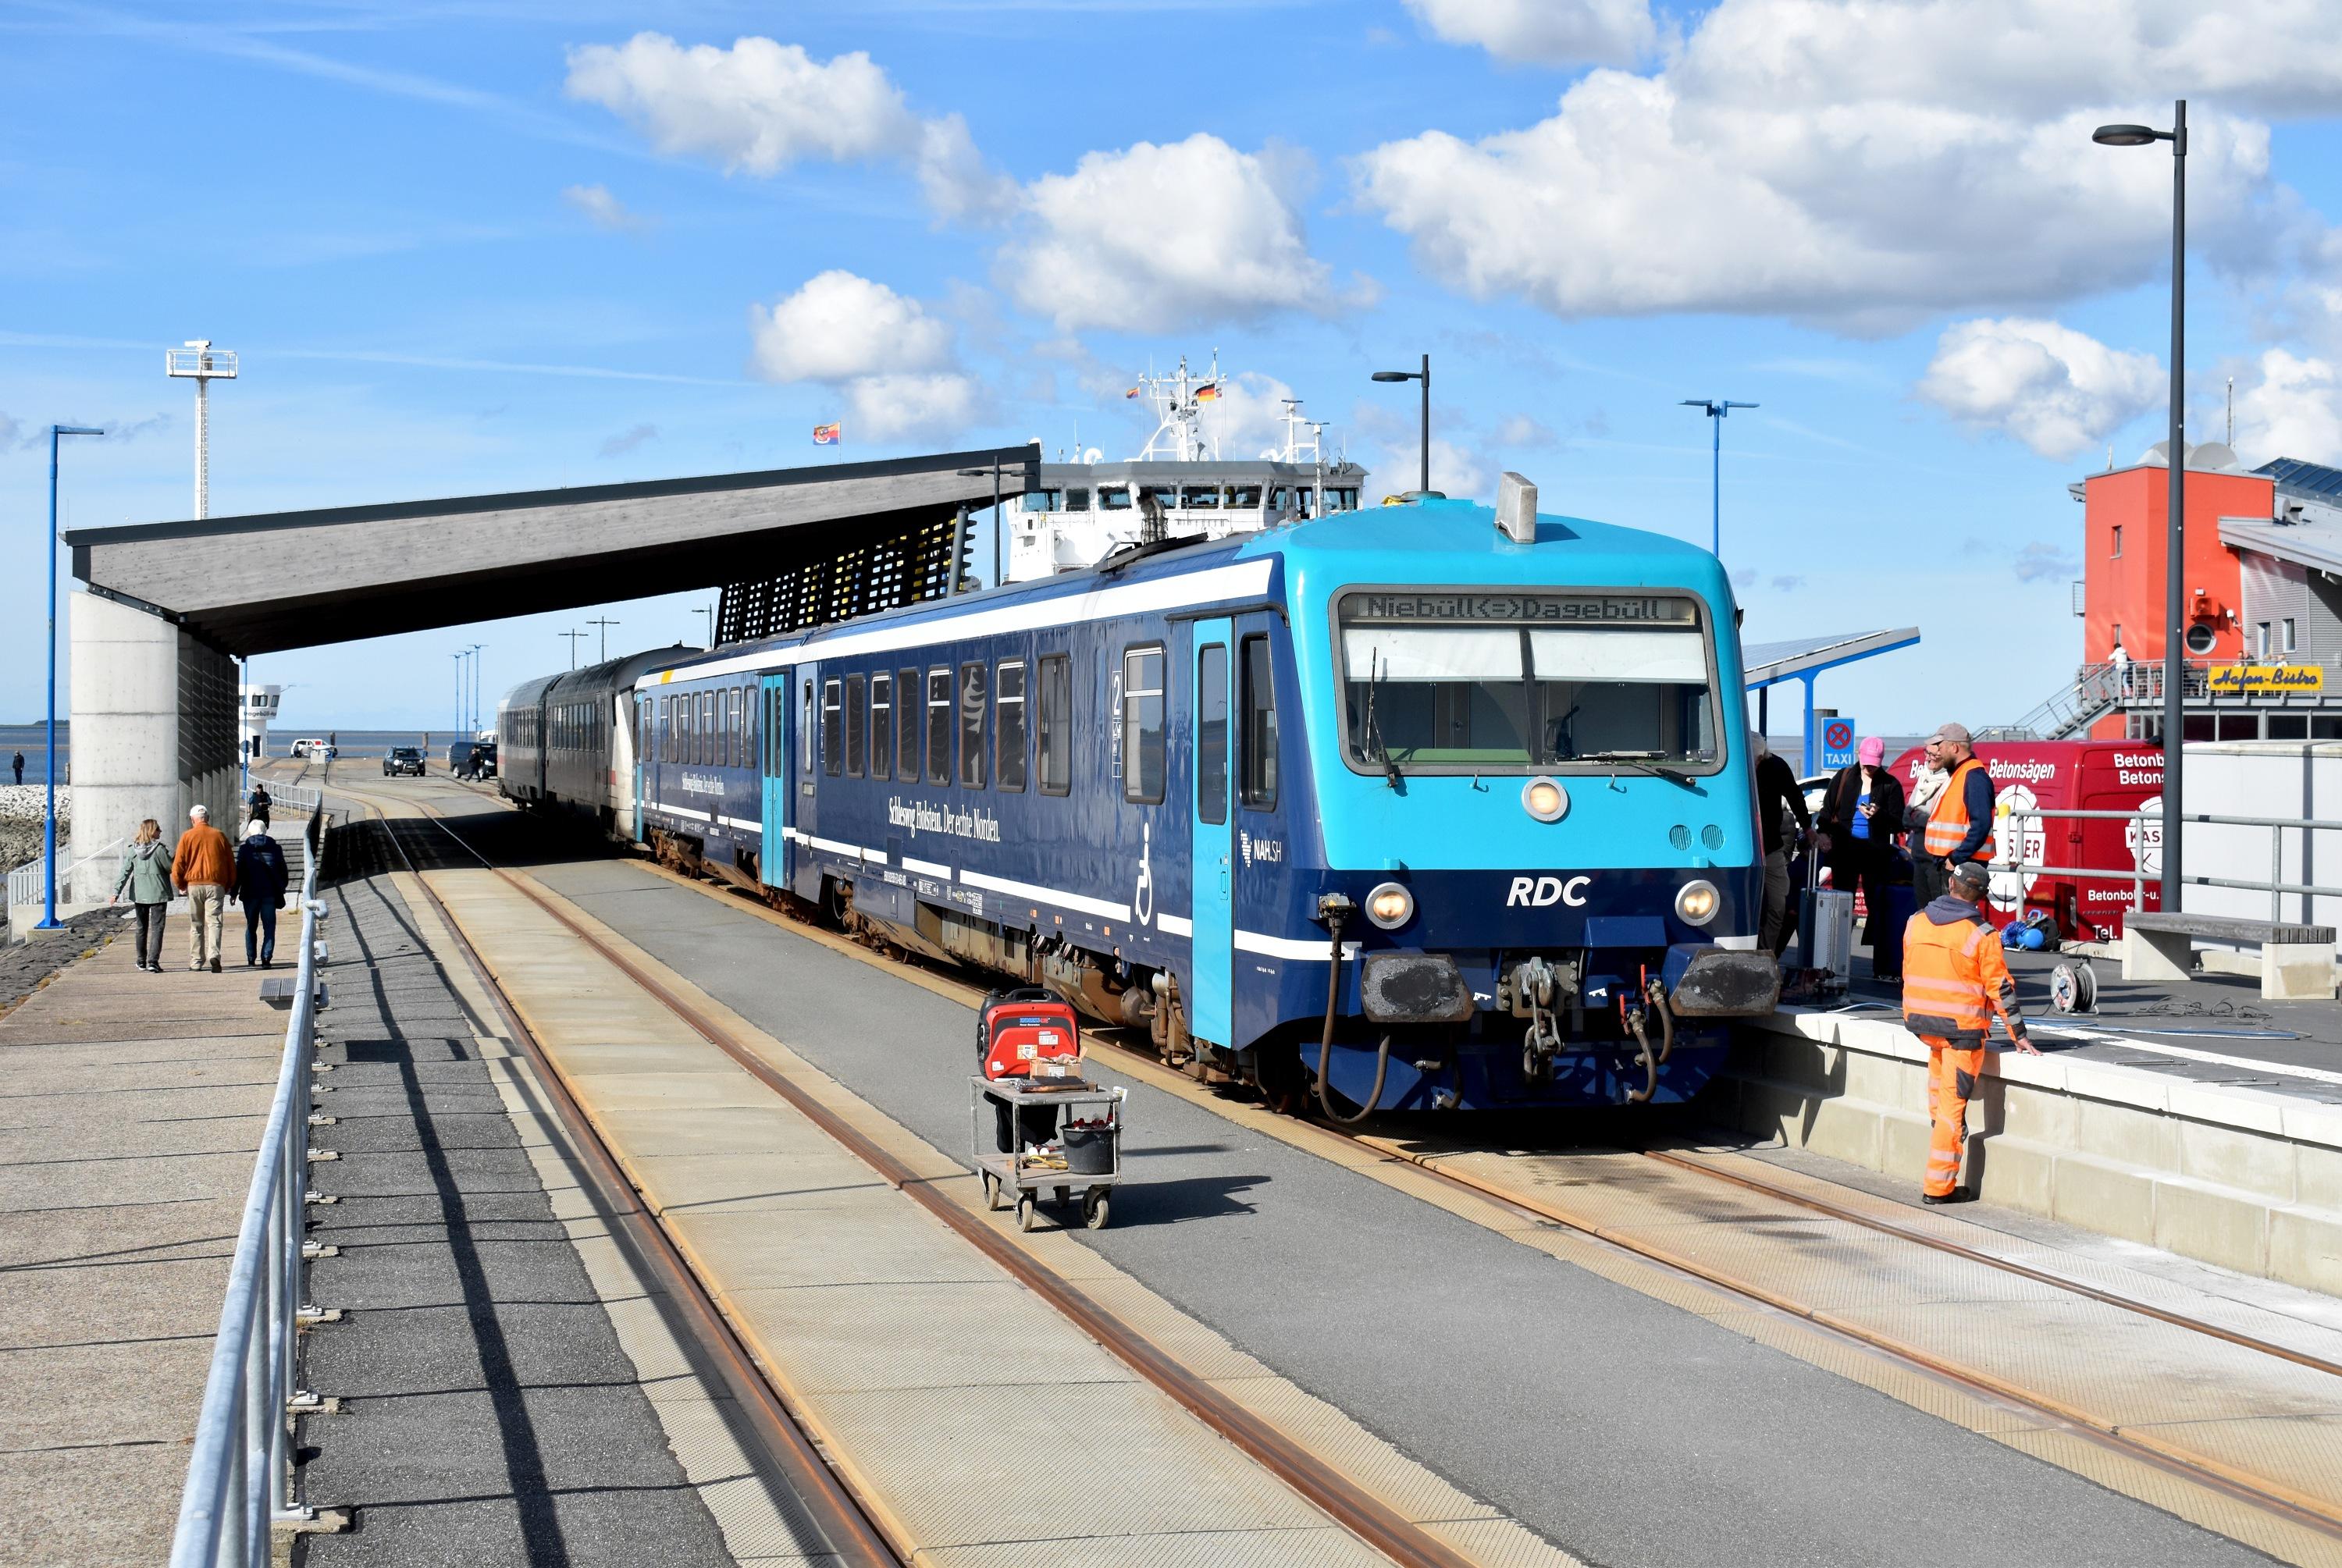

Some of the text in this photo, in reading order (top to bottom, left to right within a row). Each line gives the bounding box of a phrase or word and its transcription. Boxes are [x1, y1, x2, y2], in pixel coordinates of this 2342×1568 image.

[2212, 668, 2318, 691] Hafen-Bistro
[1113, 674, 1121, 716] 2
[1825, 753, 1852, 765] TAXI
[1909, 759, 1927, 779] Be
[1988, 758, 2055, 784] Betonsägen
[889, 795, 1001, 842] Schleswig Holstein. Der echte Norden.
[1254, 839, 1282, 862] NAH.SH
[2009, 838, 2040, 859] SER
[1506, 876, 1591, 907] RDC
[2088, 889, 2159, 901] Betonbo-u.
[2092, 924, 2118, 940] Tel.
